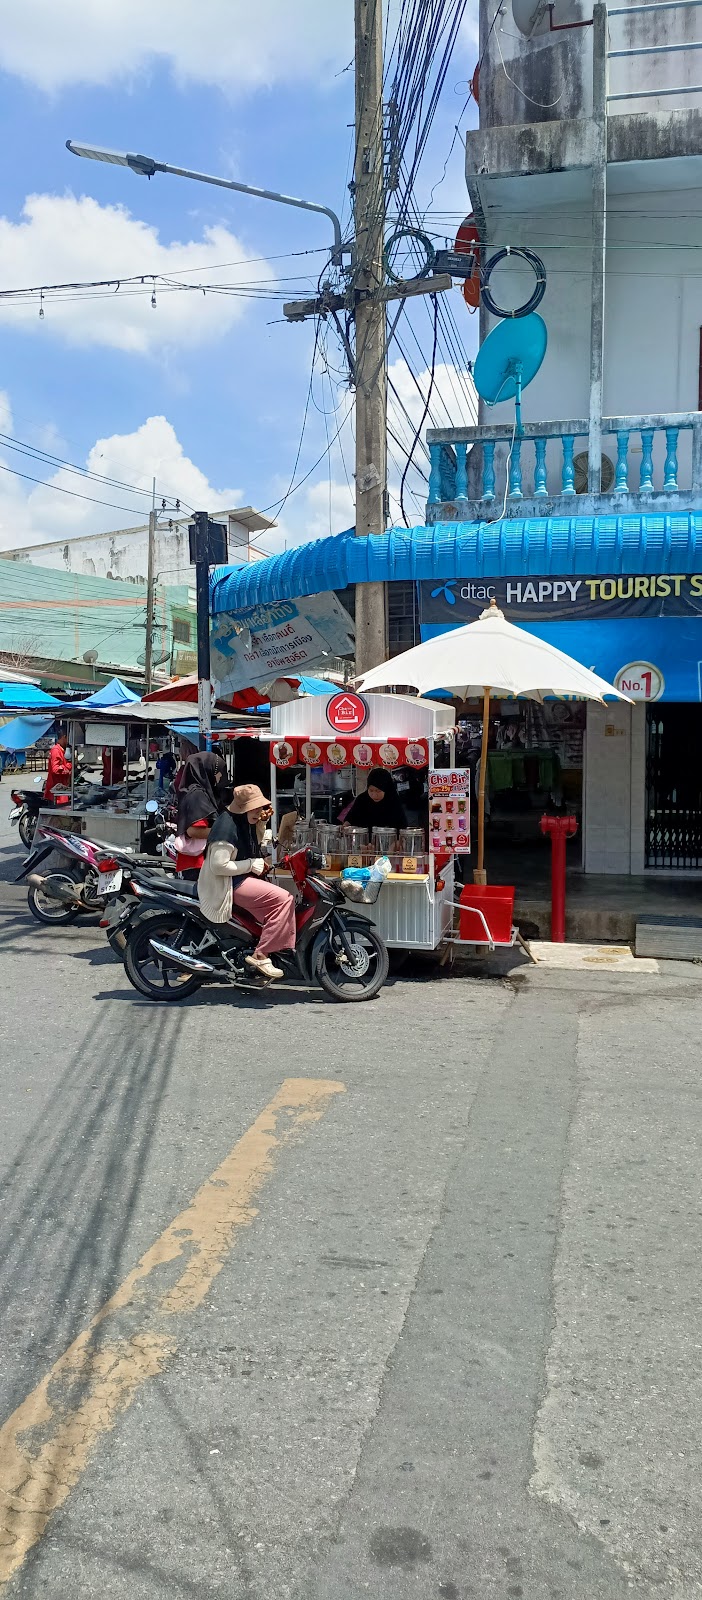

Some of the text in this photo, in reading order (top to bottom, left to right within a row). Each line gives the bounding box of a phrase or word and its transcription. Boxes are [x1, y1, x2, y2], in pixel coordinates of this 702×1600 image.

[460, 582, 496, 600] dtac
[506, 580, 582, 603] HAPPY
[585, 575, 686, 601] TOURIST
[621, 671, 652, 698] No.1
[430, 773, 466, 785] Cha Bir
